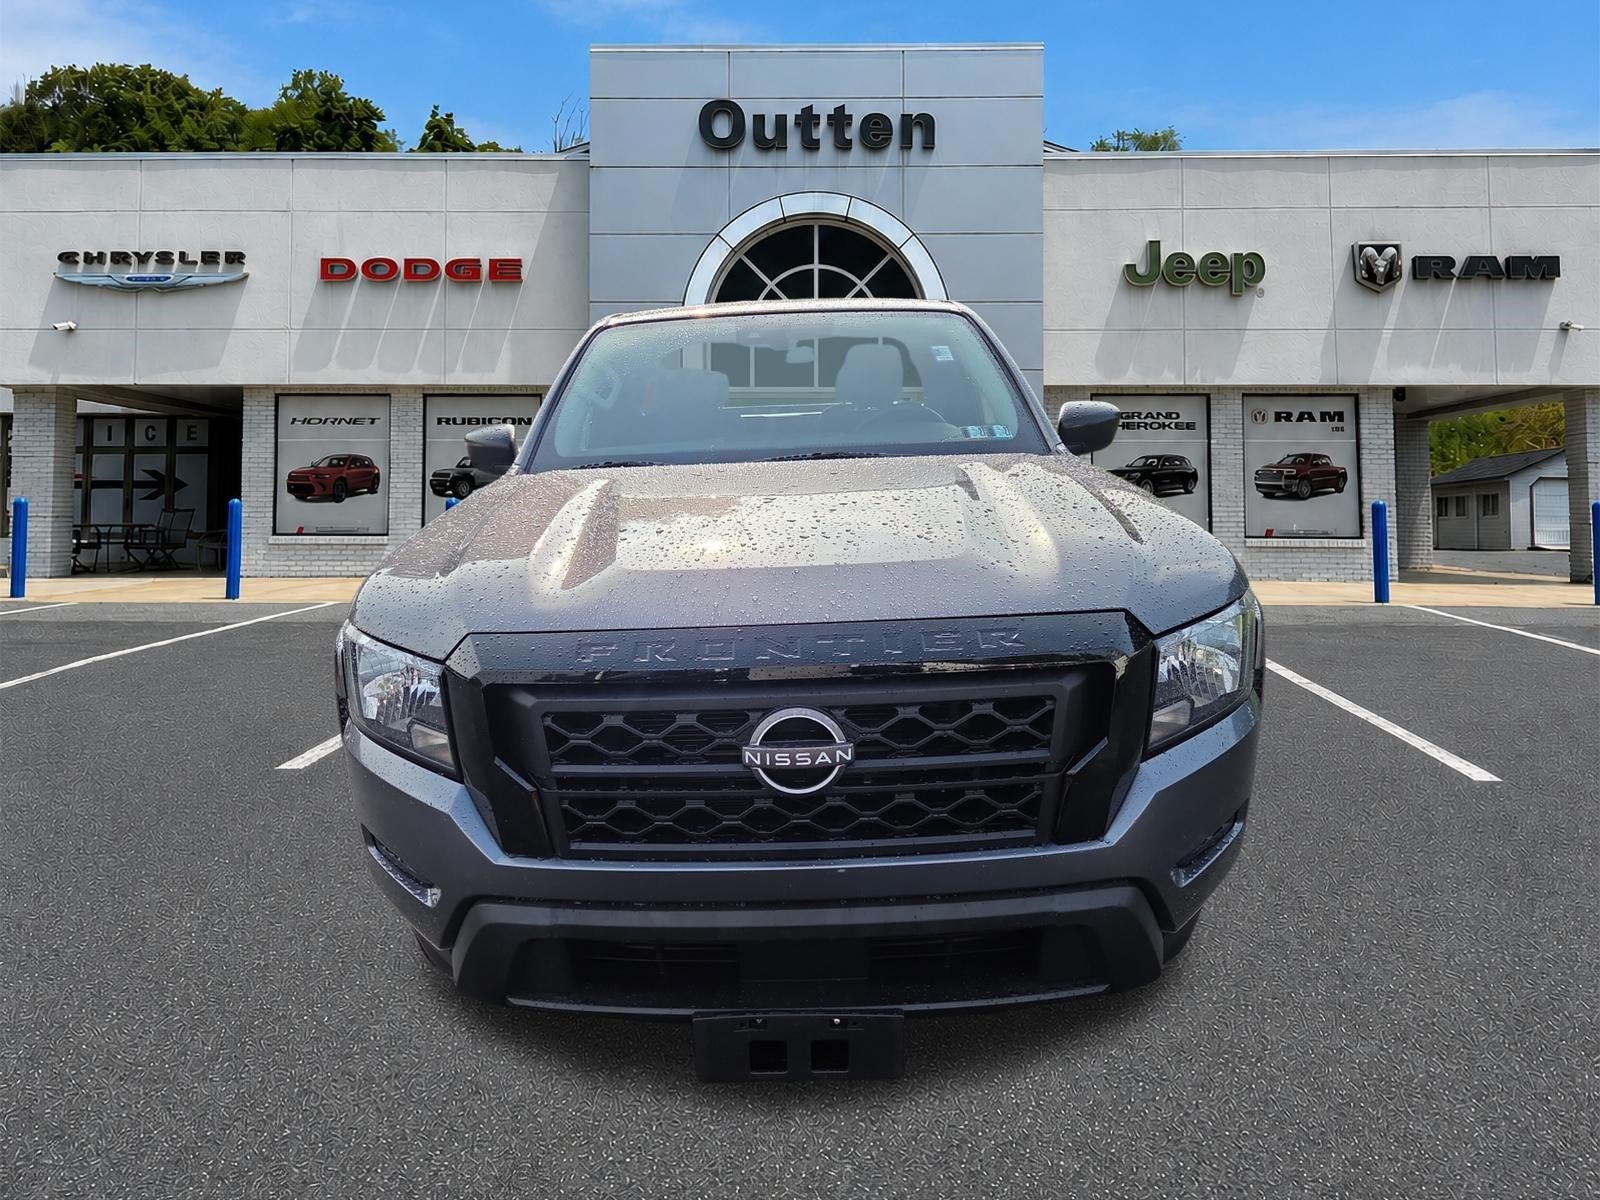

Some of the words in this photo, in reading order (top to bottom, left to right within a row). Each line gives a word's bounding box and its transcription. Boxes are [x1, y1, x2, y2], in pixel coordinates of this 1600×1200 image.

[699, 99, 936, 150] Outten
[57, 250, 247, 266] CHRYSLER
[320, 257, 523, 282] DODGE
[1123, 240, 1266, 296] Jeep
[1411, 255, 1561, 280] RAM
[290, 417, 381, 426] HORNET
[436, 417, 532, 426] RUBICON
[1119, 411, 1180, 420] GRAND
[1274, 411, 1345, 423] RAM
[1118, 421, 1196, 431] HEROKEE
[575, 629, 1025, 663] FRONTIER
[744, 746, 853, 767] NISSAN
